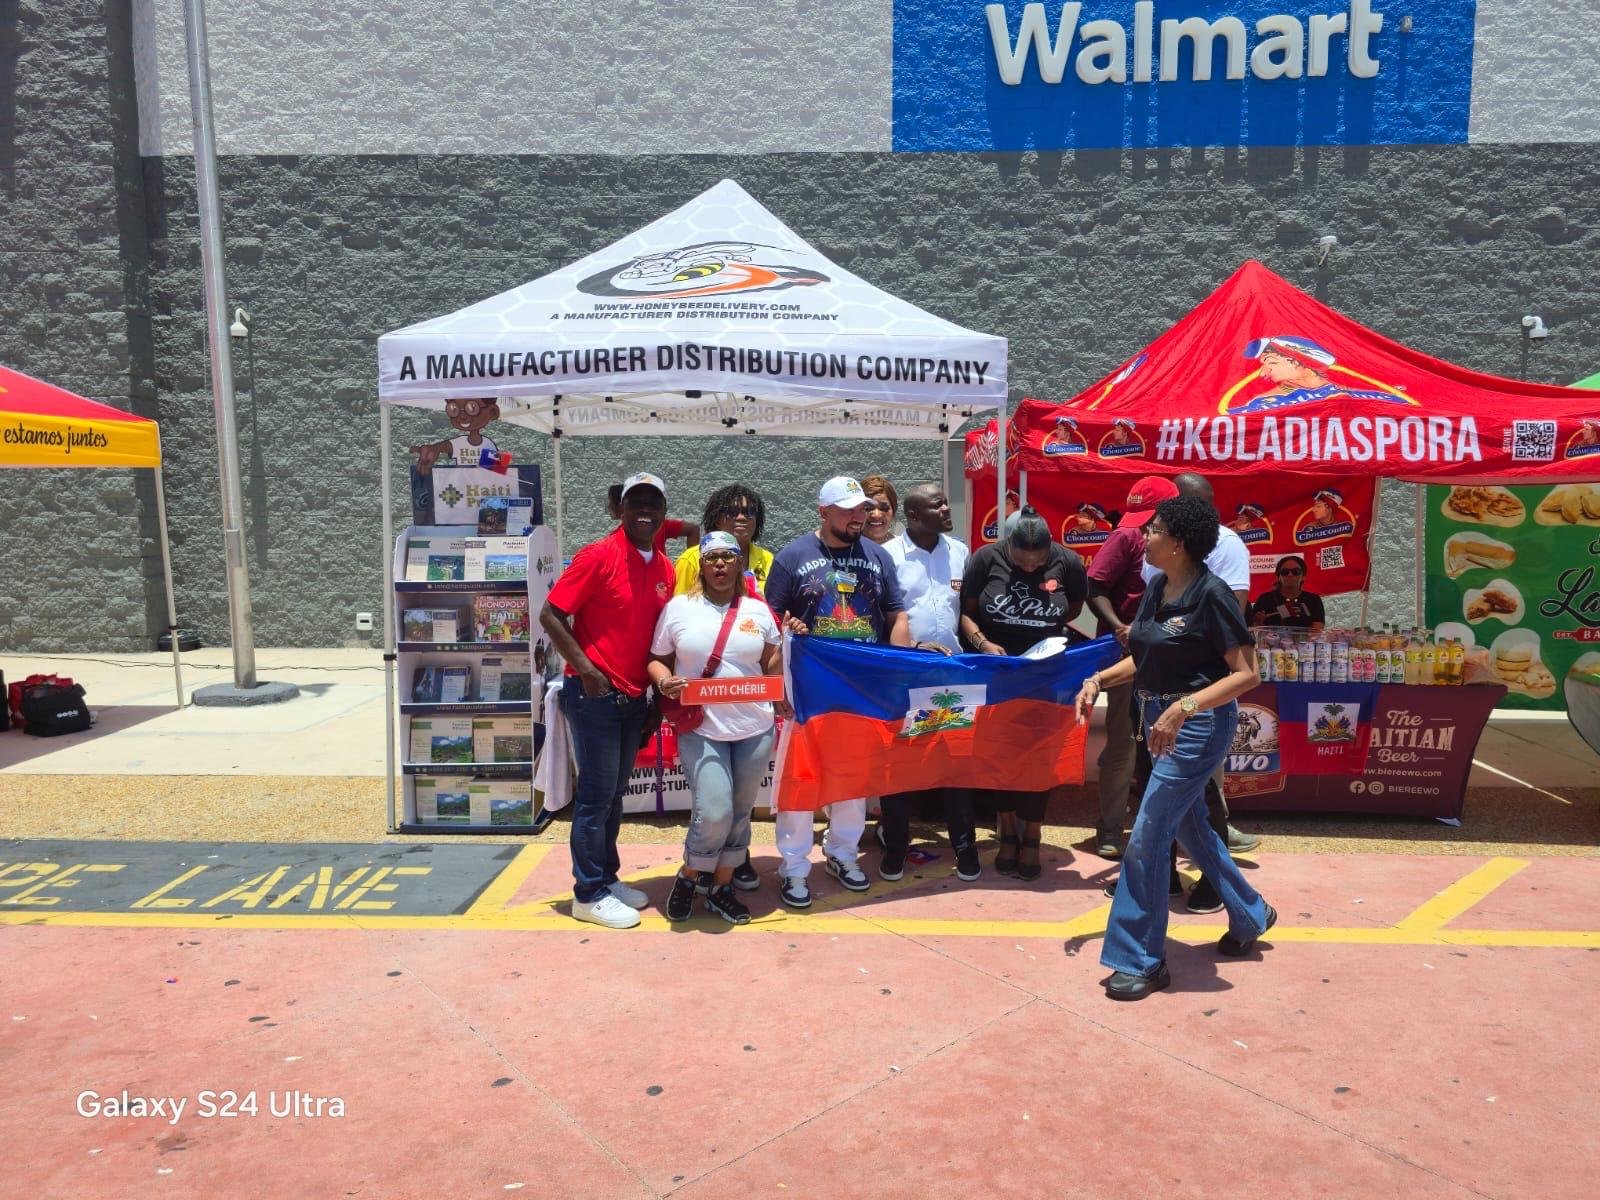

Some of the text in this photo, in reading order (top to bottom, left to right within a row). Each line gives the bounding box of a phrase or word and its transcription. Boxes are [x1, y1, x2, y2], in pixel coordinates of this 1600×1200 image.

[973, 0, 1384, 85] Walmart
[594, 302, 800, 312] WWW.HONEYBEEDELIVERY.COM
[564, 312, 672, 320] MANUFACTURER
[676, 311, 768, 320] DISTRIBUTION
[772, 313, 839, 321] COMPANY
[399, 344, 990, 385] A MANUFACTURER DISTRIBUTION COMPANY
[4, 423, 109, 454] estamos juntos
[1156, 417, 1482, 463] #KOLADIASPORA
[466, 485, 512, 497] Haiti
[1299, 525, 1351, 542] Choucoune
[480, 600, 526, 609] MONOPOLY
[985, 594, 1064, 620] La Paix
[700, 682, 767, 697] AYITI CHÉRIE
[1387, 710, 1423, 726] The
[1369, 726, 1456, 751] AITIAN
[1317, 745, 1344, 756] HAITI
[1377, 748, 1419, 763] Beer
[1229, 754, 1269, 771] WO
[1388, 785, 1440, 795] BIEREEWO
[130, 866, 431, 909] LANE
